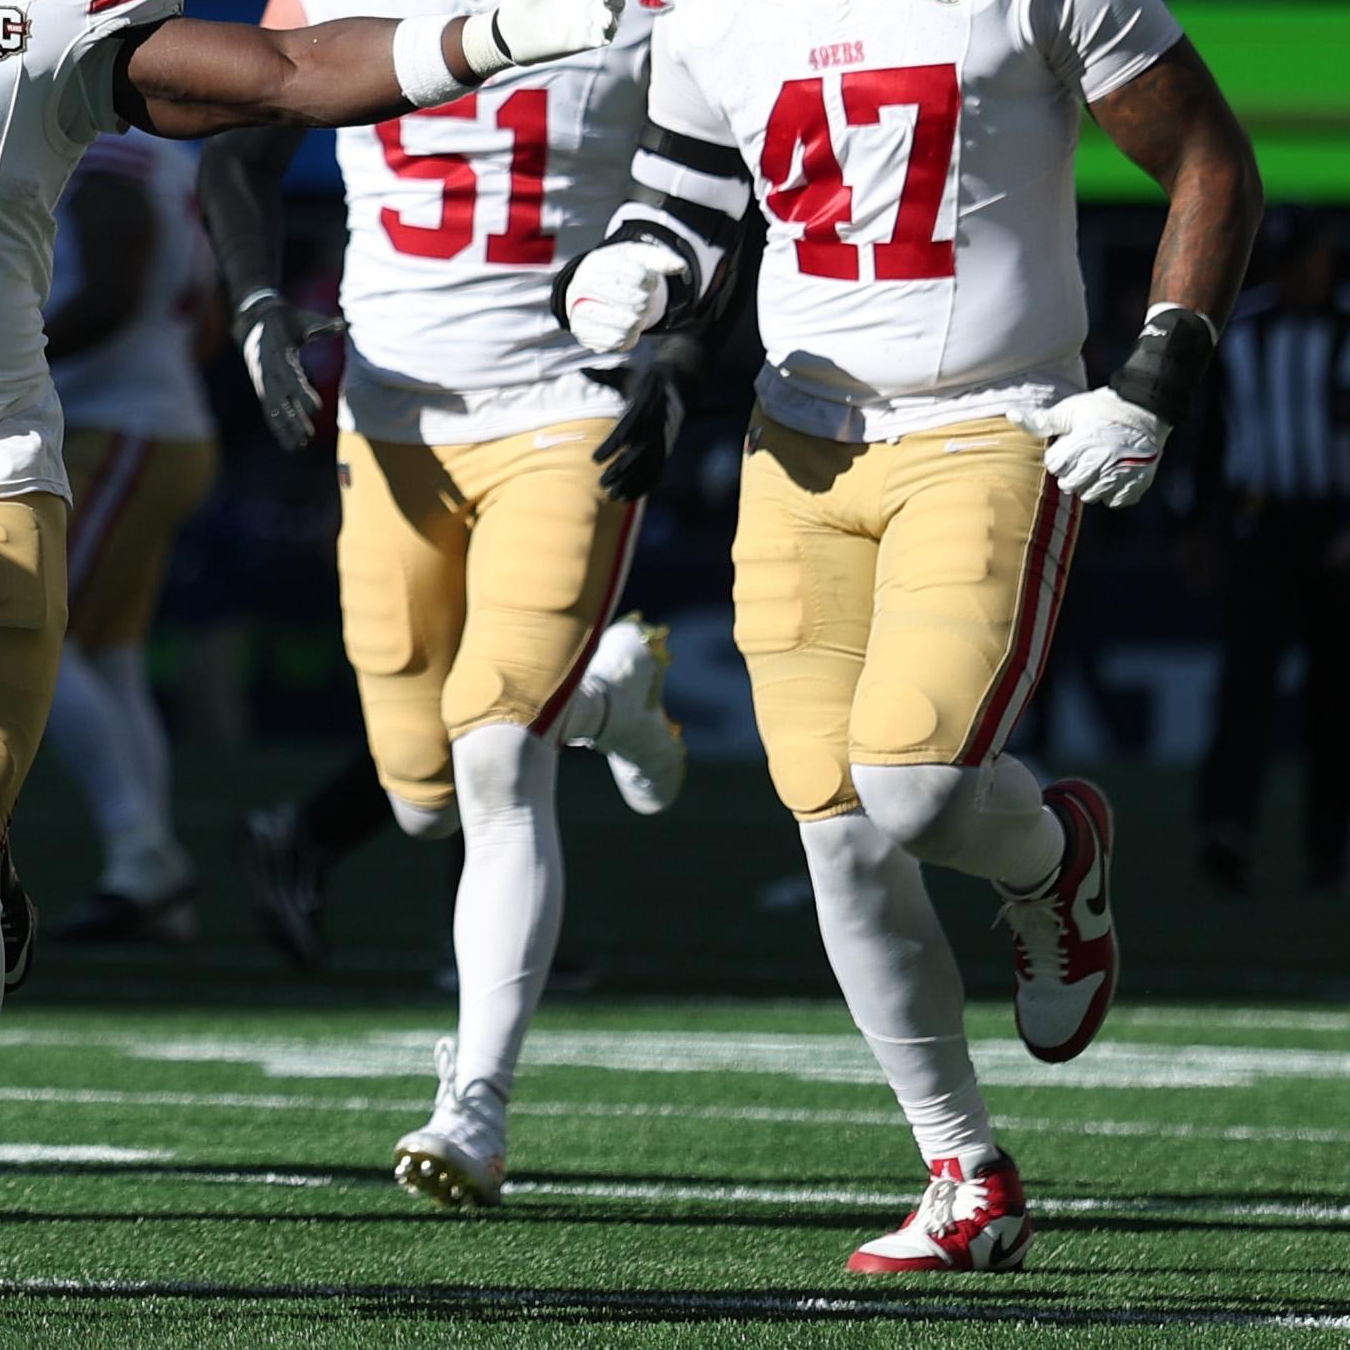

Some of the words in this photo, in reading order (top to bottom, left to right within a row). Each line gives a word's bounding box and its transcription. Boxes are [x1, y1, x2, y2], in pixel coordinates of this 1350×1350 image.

[808, 41, 865, 71] 49ERS
[375, 88, 555, 265] 51
[760, 62, 959, 282] 47
